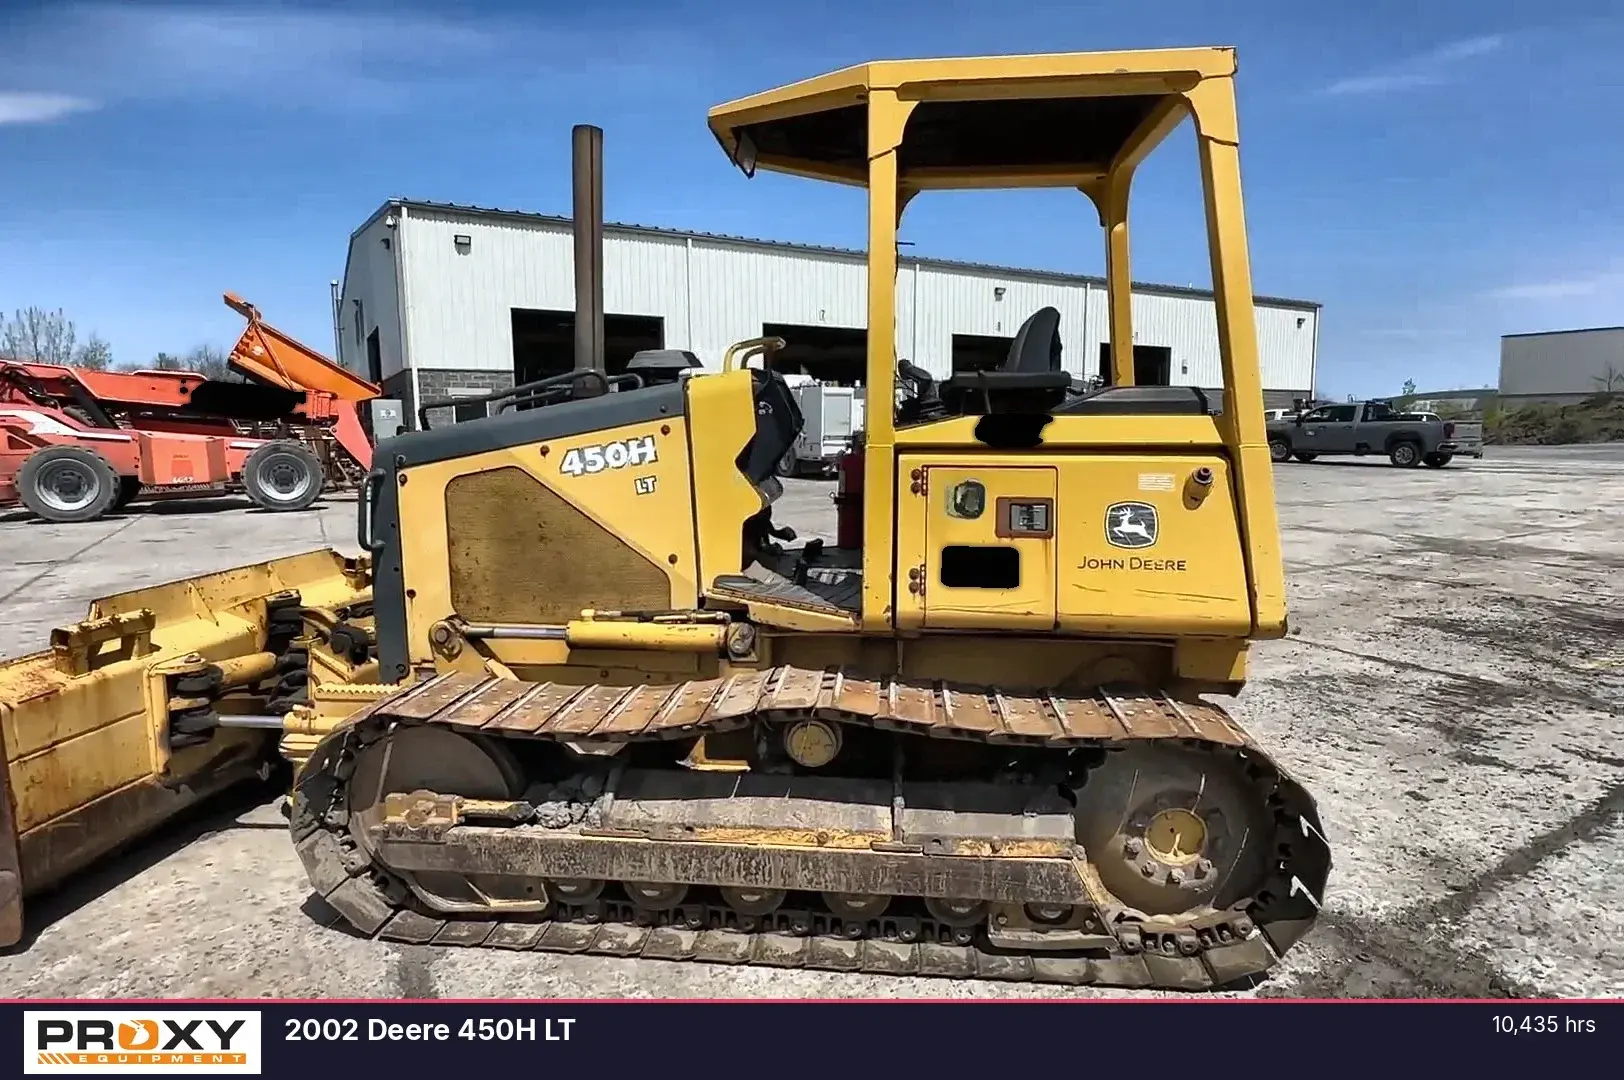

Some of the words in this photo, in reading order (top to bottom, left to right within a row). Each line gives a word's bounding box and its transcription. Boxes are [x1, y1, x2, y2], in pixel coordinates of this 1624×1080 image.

[560, 435, 658, 477] 450H
[634, 476, 657, 495] LT
[1078, 556, 1124, 570] JOHN
[1129, 557, 1187, 571] DEERE
